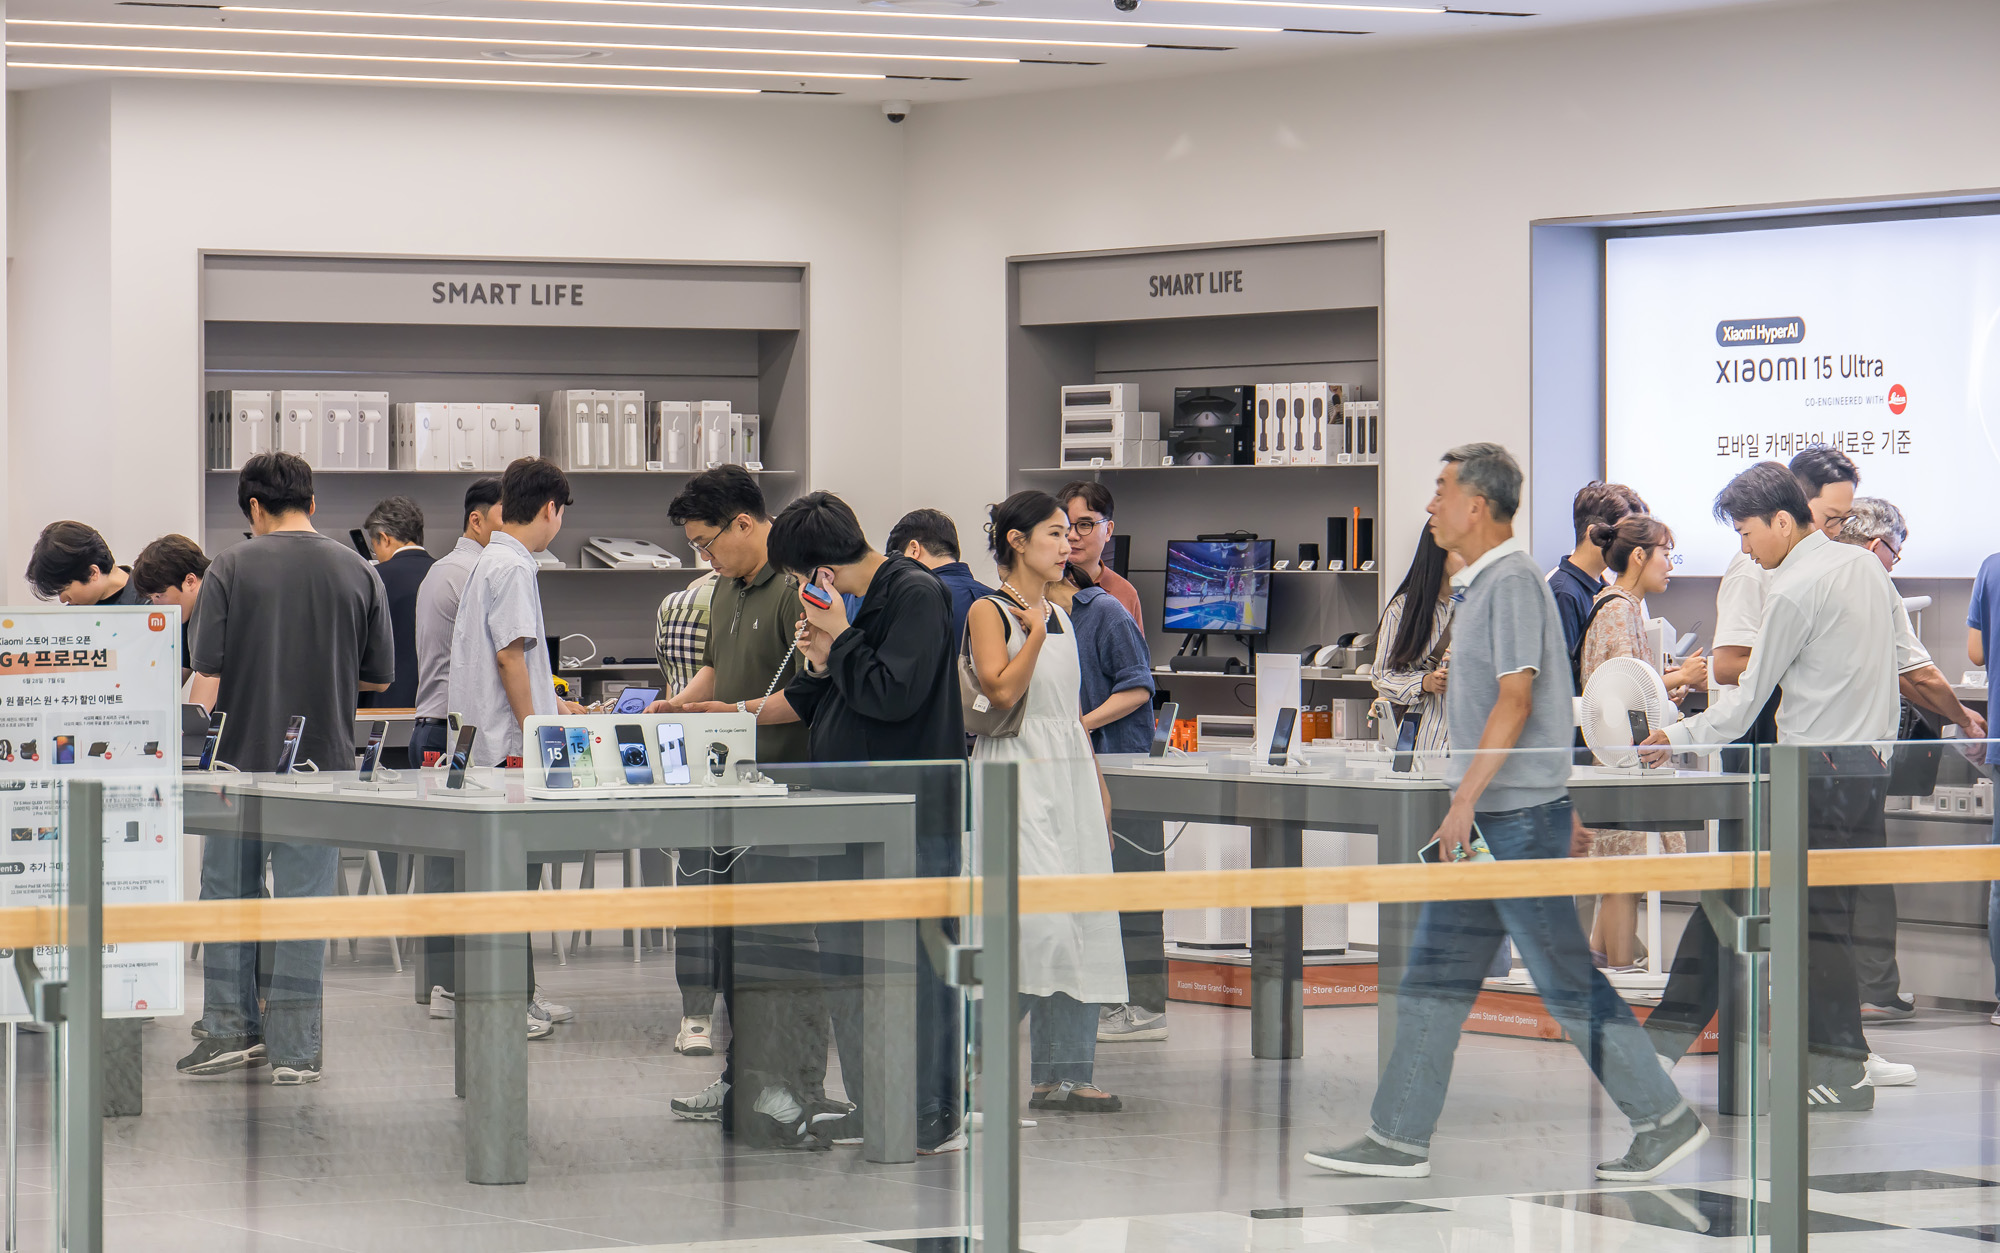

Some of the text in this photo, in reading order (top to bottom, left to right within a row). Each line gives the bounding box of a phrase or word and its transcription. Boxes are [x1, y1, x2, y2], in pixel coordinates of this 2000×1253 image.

[1149, 270, 1243, 297] SMART LIFE
[432, 282, 584, 306] SMART LIFE
[1722, 322, 1799, 343] Xiaomi HyperAI
[1814, 355, 1833, 380] 15
[1840, 354, 1884, 379] Ultra
[1805, 396, 1863, 407] CO-ENGINEERED
[1866, 395, 1884, 405] WITH
[1717, 433, 1759, 458] 모바일
[1832, 430, 1875, 455] 새로운
[1882, 429, 1912, 454] 기준
[26, 636, 49, 645] 스토어
[51, 636, 74, 646] 그랜드
[76, 636, 91, 645] 오픈
[17, 652, 30, 667] 4
[34, 648, 108, 668] 프로모션
[6, 696, 14, 706] 원
[17, 696, 42, 706] 플러스
[44, 695, 52, 706] 원
[61, 696, 78, 706] 추가
[80, 695, 96, 705] 할인
[98, 694, 123, 705] 이벤트
[547, 748, 562, 760] 15
[571, 742, 585, 753] 15
[30, 862, 46, 872] 추가
[1177, 980, 1242, 996] Xiaomi Store Grand Opening
[1312, 986, 1332, 994] Store
[1334, 985, 1356, 993] Grand
[1483, 1012, 1497, 1021] Store
[1498, 1013, 1514, 1023] Grand
[1515, 1015, 1538, 1027] Opening
